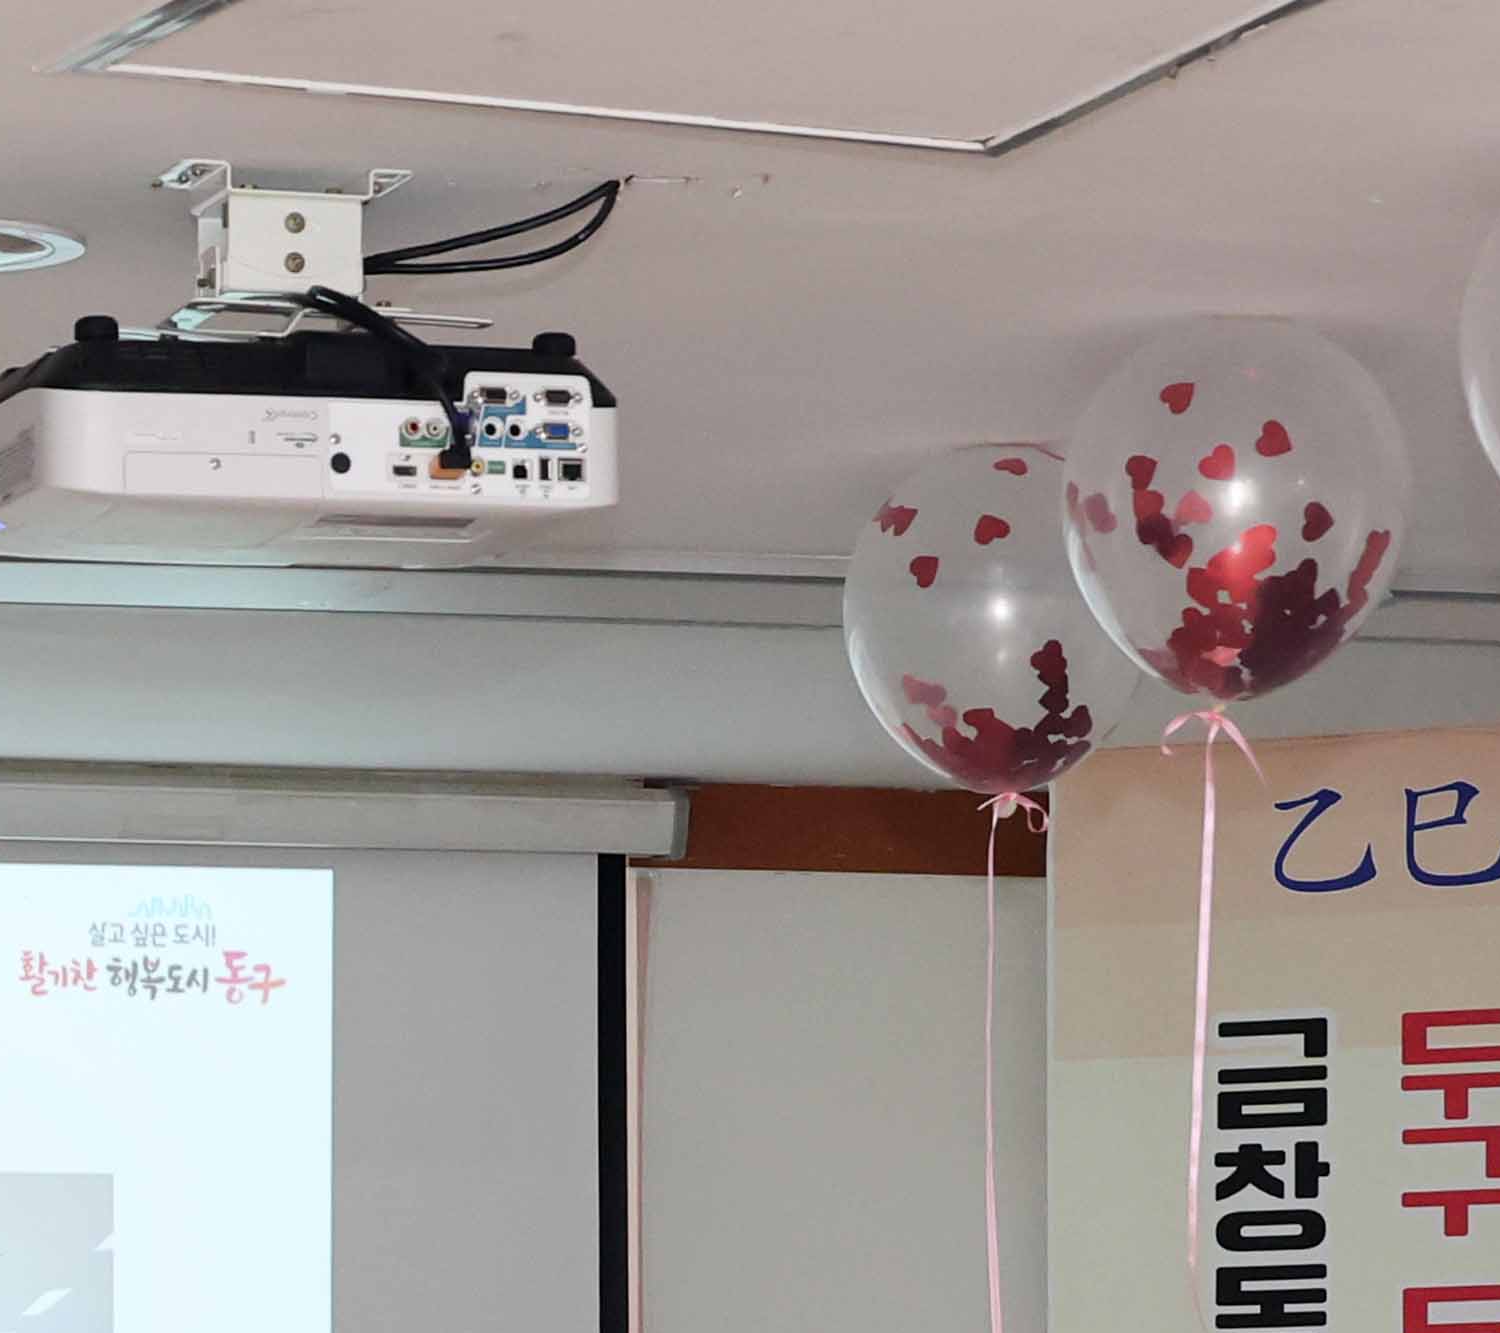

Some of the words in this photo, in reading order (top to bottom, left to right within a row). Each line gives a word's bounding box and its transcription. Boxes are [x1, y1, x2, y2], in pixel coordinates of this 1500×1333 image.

[18, 949, 98, 997] 활기찬
[105, 955, 210, 1001] 행복도시
[214, 949, 287, 1006] 동구
